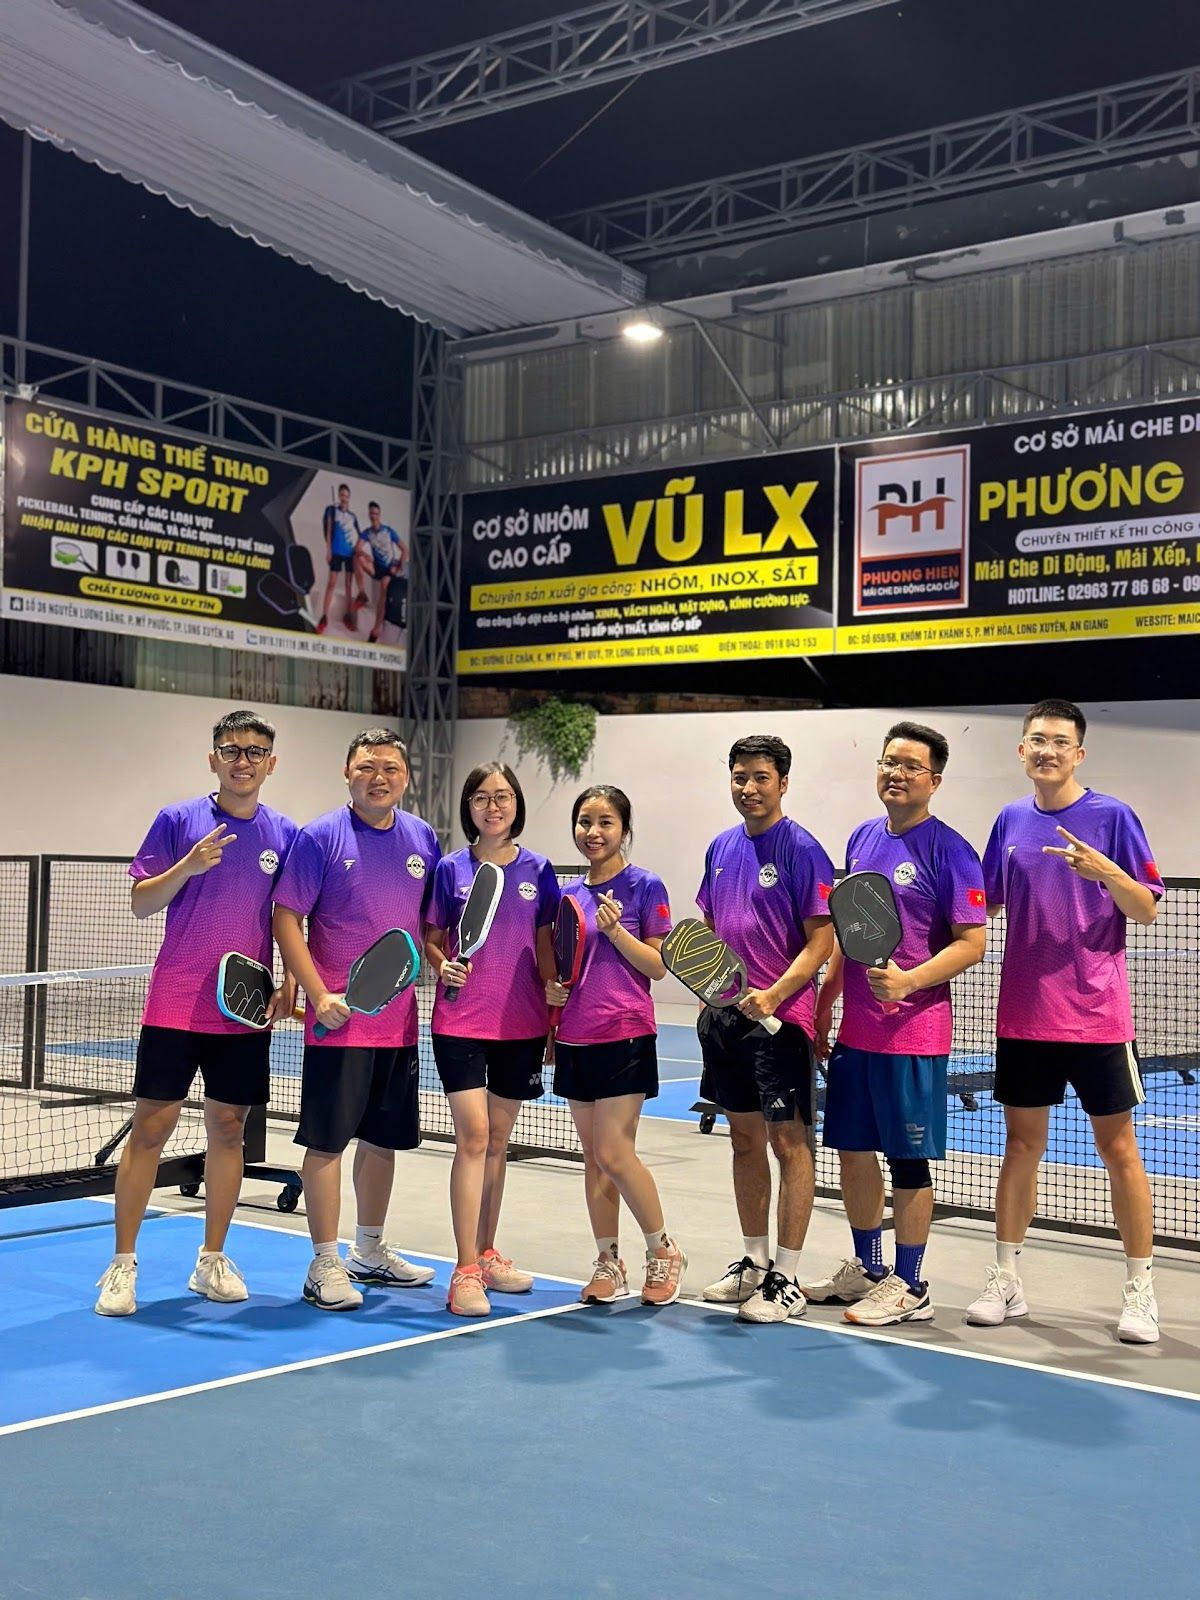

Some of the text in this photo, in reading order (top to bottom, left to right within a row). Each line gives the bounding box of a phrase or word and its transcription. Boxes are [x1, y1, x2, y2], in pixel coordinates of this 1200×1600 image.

[25, 410, 269, 486] CỬA HÀNG THỂ THAO
[1013, 430, 1047, 454] CƠ
[1051, 423, 1080, 450] SỞ
[1084, 418, 1124, 446] MÁI
[1130, 416, 1174, 440] CHE
[49, 447, 249, 514] KPH SPORT
[979, 460, 1185, 522] PHƯƠNG
[16, 495, 78, 518] PICKLEBALL,
[80, 507, 117, 526] TENNIS,
[166, 523, 179, 537] VÀ
[180, 526, 198, 540] CÁC
[253, 541, 275, 556] THAO
[90, 494, 214, 530] CUNG CẤP CÁC LOẠI VỢT
[472, 504, 589, 541] CƠ SỞ NHÔM
[601, 476, 820, 566] VŨ LX
[21, 513, 53, 531] NHẬN
[106, 528, 129, 544] CÁC
[129, 533, 154, 550] LOẠI
[155, 538, 174, 553] VỢT
[175, 541, 211, 559] TENNIS
[211, 546, 225, 561] VÀ
[1021, 532, 1071, 547] CHUYÊN
[1074, 526, 1106, 542] THIẾT
[1110, 522, 1129, 539] KẾ
[1128, 525, 1148, 537] THI
[1152, 520, 1194, 535] CÔNG
[487, 534, 572, 571] CAO CẤP
[974, 559, 1005, 581] Mái
[1008, 558, 1039, 578] Che
[1043, 555, 1060, 576] Di
[1064, 552, 1111, 577] Động,
[1115, 547, 1148, 570] Mái
[1152, 541, 1191, 567] Xếp,
[478, 559, 808, 605] Chuyên sản xuất gia công: NHÔM, INOX, SẮT
[862, 565, 959, 586] PHUONG HIEN
[877, 586, 892, 596] CHE
[893, 586, 902, 594] DI
[926, 582, 943, 592] CAO
[1008, 585, 1065, 605] HOTLINE:
[1067, 582, 1109, 601] 02963
[1111, 580, 1129, 598] 77
[1131, 578, 1150, 596] 86
[1152, 577, 1170, 594] 68
[87, 581, 216, 610] CHẤT LƯỢNG VÀ UY TÍN
[476, 617, 491, 628] Gia
[492, 615, 512, 629] công
[512, 612, 526, 627] lắp
[542, 611, 559, 624] các
[559, 610, 570, 624] hệ
[571, 609, 595, 621] nhôm
[623, 603, 649, 617] VÁCH
[729, 595, 752, 610] KÍNH
[753, 592, 788, 608] CƯỜNG
[790, 592, 810, 608] LỰC
[685, 615, 702, 630] BẾP
[939, 627, 965, 640] KHÁNH
[974, 628, 982, 637] P.
[983, 624, 995, 637] MỸ
[1016, 623, 1037, 635] LONG
[1069, 620, 1082, 631] AN
[1083, 618, 1109, 630] GIANG
[1135, 613, 1175, 628] WEBSITE:
[616, 646, 634, 659] LONG
[664, 644, 675, 655] AN
[676, 643, 699, 654] GIANG
[765, 639, 784, 650] 0918
[786, 637, 800, 649] 043
[803, 636, 817, 648] 153
